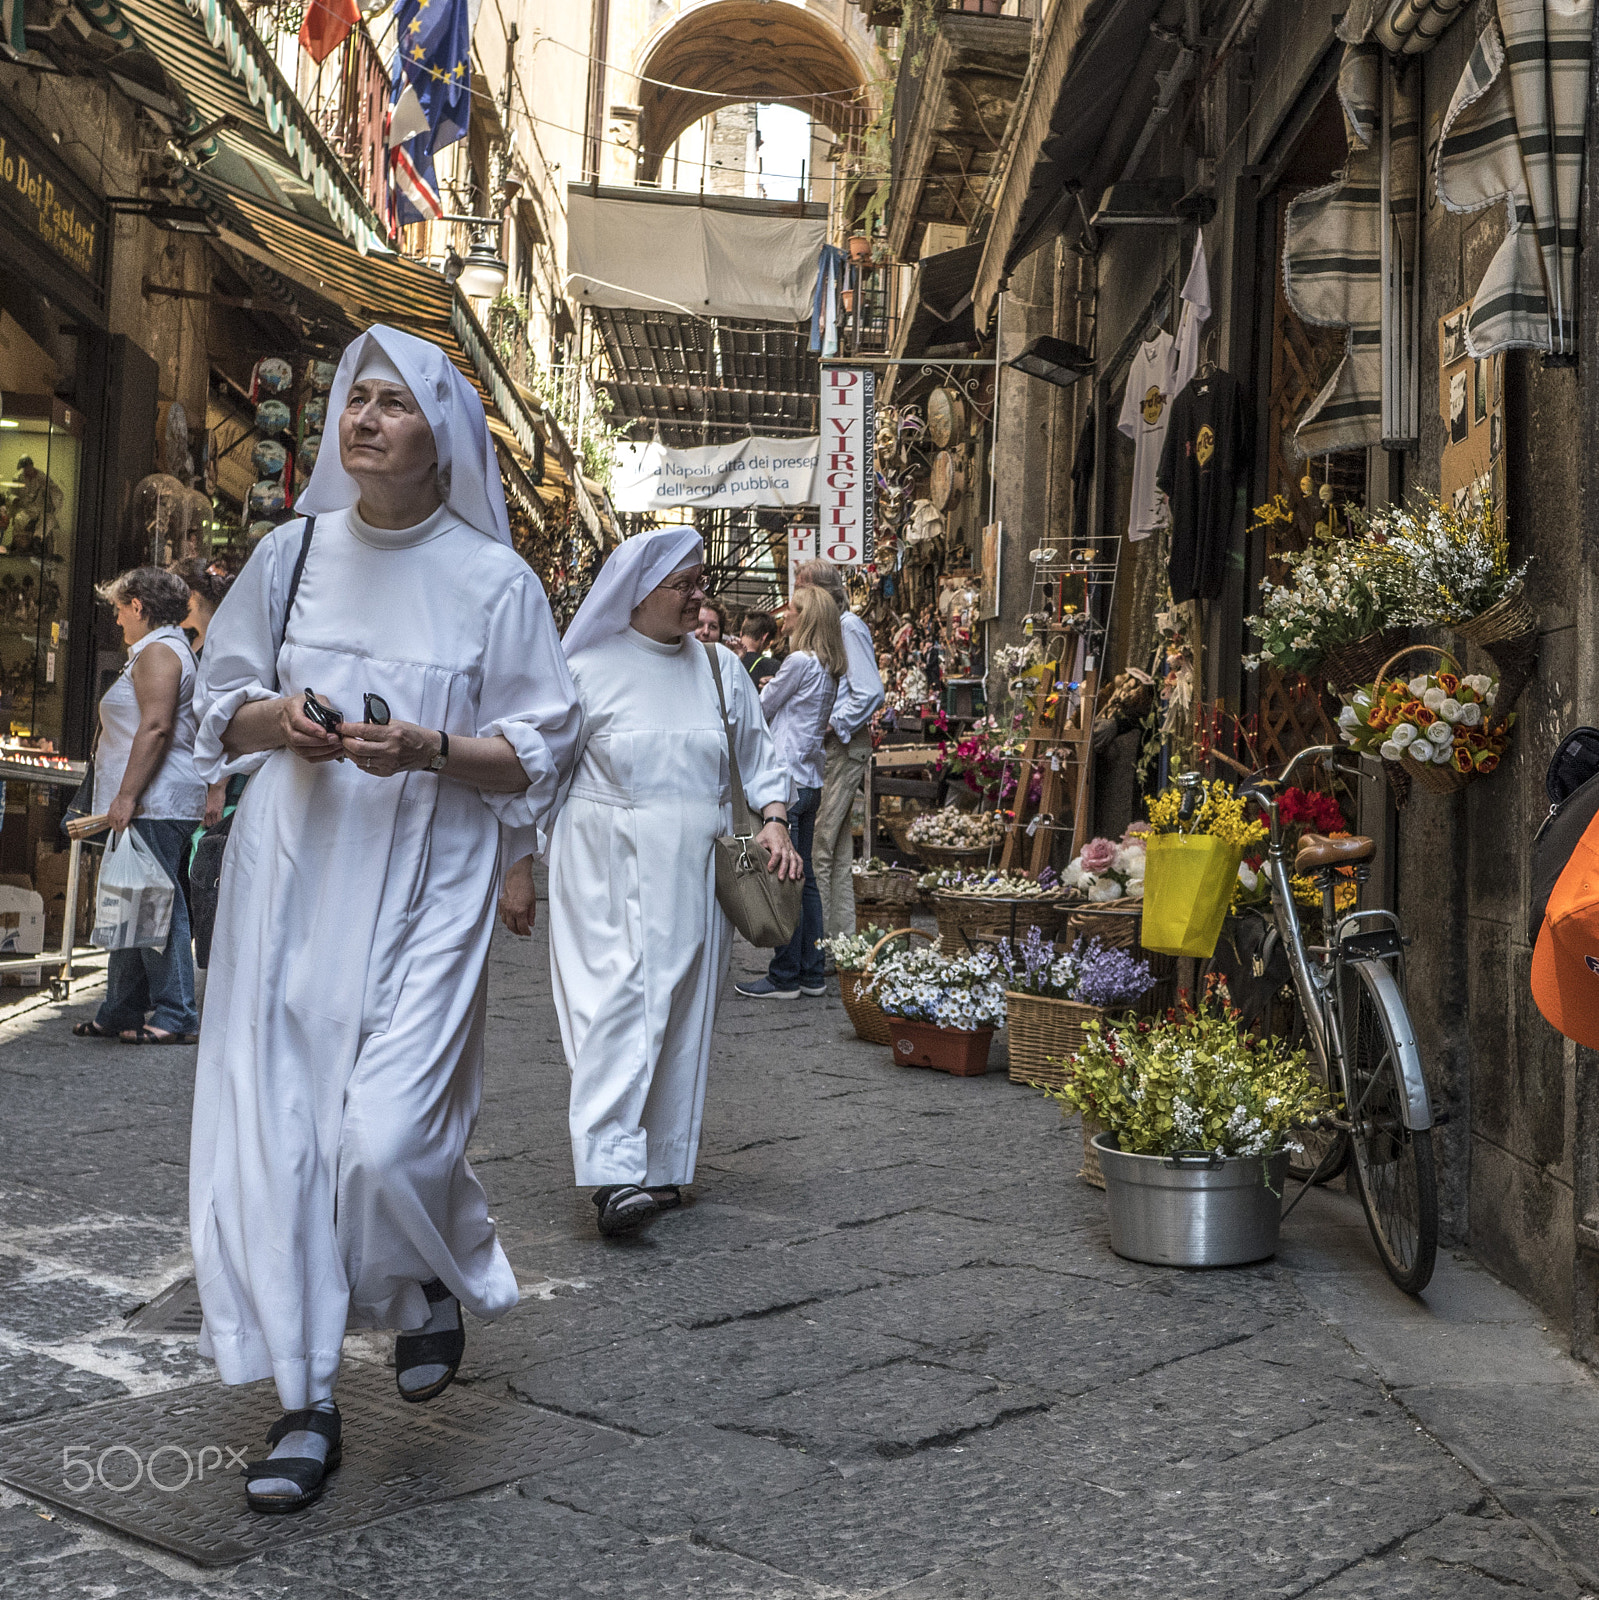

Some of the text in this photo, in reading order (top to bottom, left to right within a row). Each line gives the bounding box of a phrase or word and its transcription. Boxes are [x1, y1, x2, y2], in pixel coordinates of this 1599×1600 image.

[17, 155, 42, 208] Dei
[44, 180, 95, 257] Pastori
[864, 371, 873, 397] 1830
[865, 404, 873, 425] DAL
[665, 461, 714, 479] Napoli,
[717, 457, 745, 474] città
[748, 456, 769, 470] dei
[826, 370, 858, 562] DI VIRGILIO
[864, 429, 873, 492] GENNARO
[656, 476, 789, 498] dell'acqua pubblica
[864, 506, 873, 561] ROSARIO
